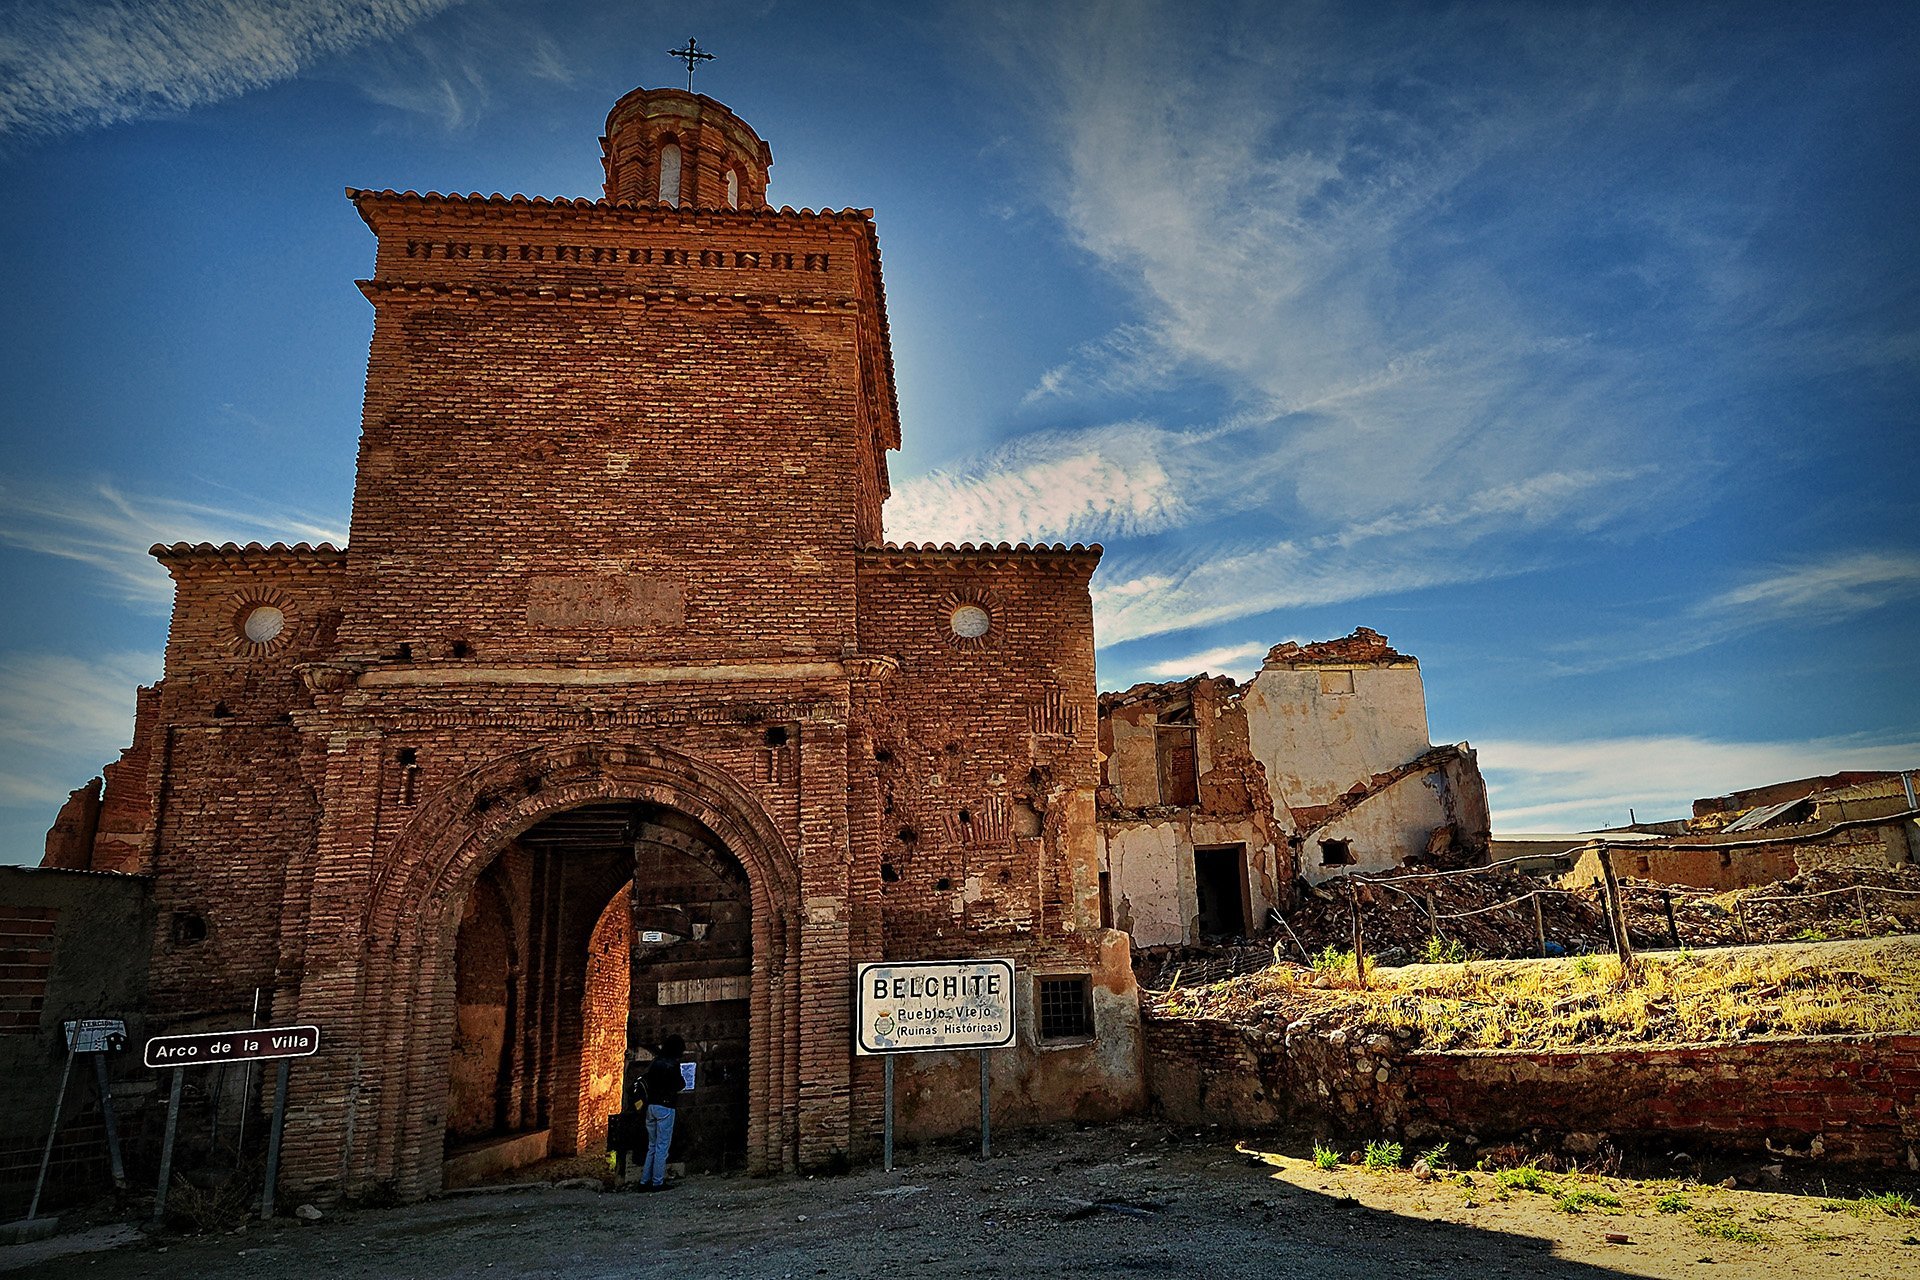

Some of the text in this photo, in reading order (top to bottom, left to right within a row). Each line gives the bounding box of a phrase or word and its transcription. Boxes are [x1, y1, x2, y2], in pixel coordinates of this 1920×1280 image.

[873, 974, 1000, 999] BELCHITE
[898, 1006, 990, 1021] Pueblo Viejo
[896, 1022, 1002, 1037] (Ruinas Históricas)
[156, 1034, 309, 1058] Arco de la Villa
